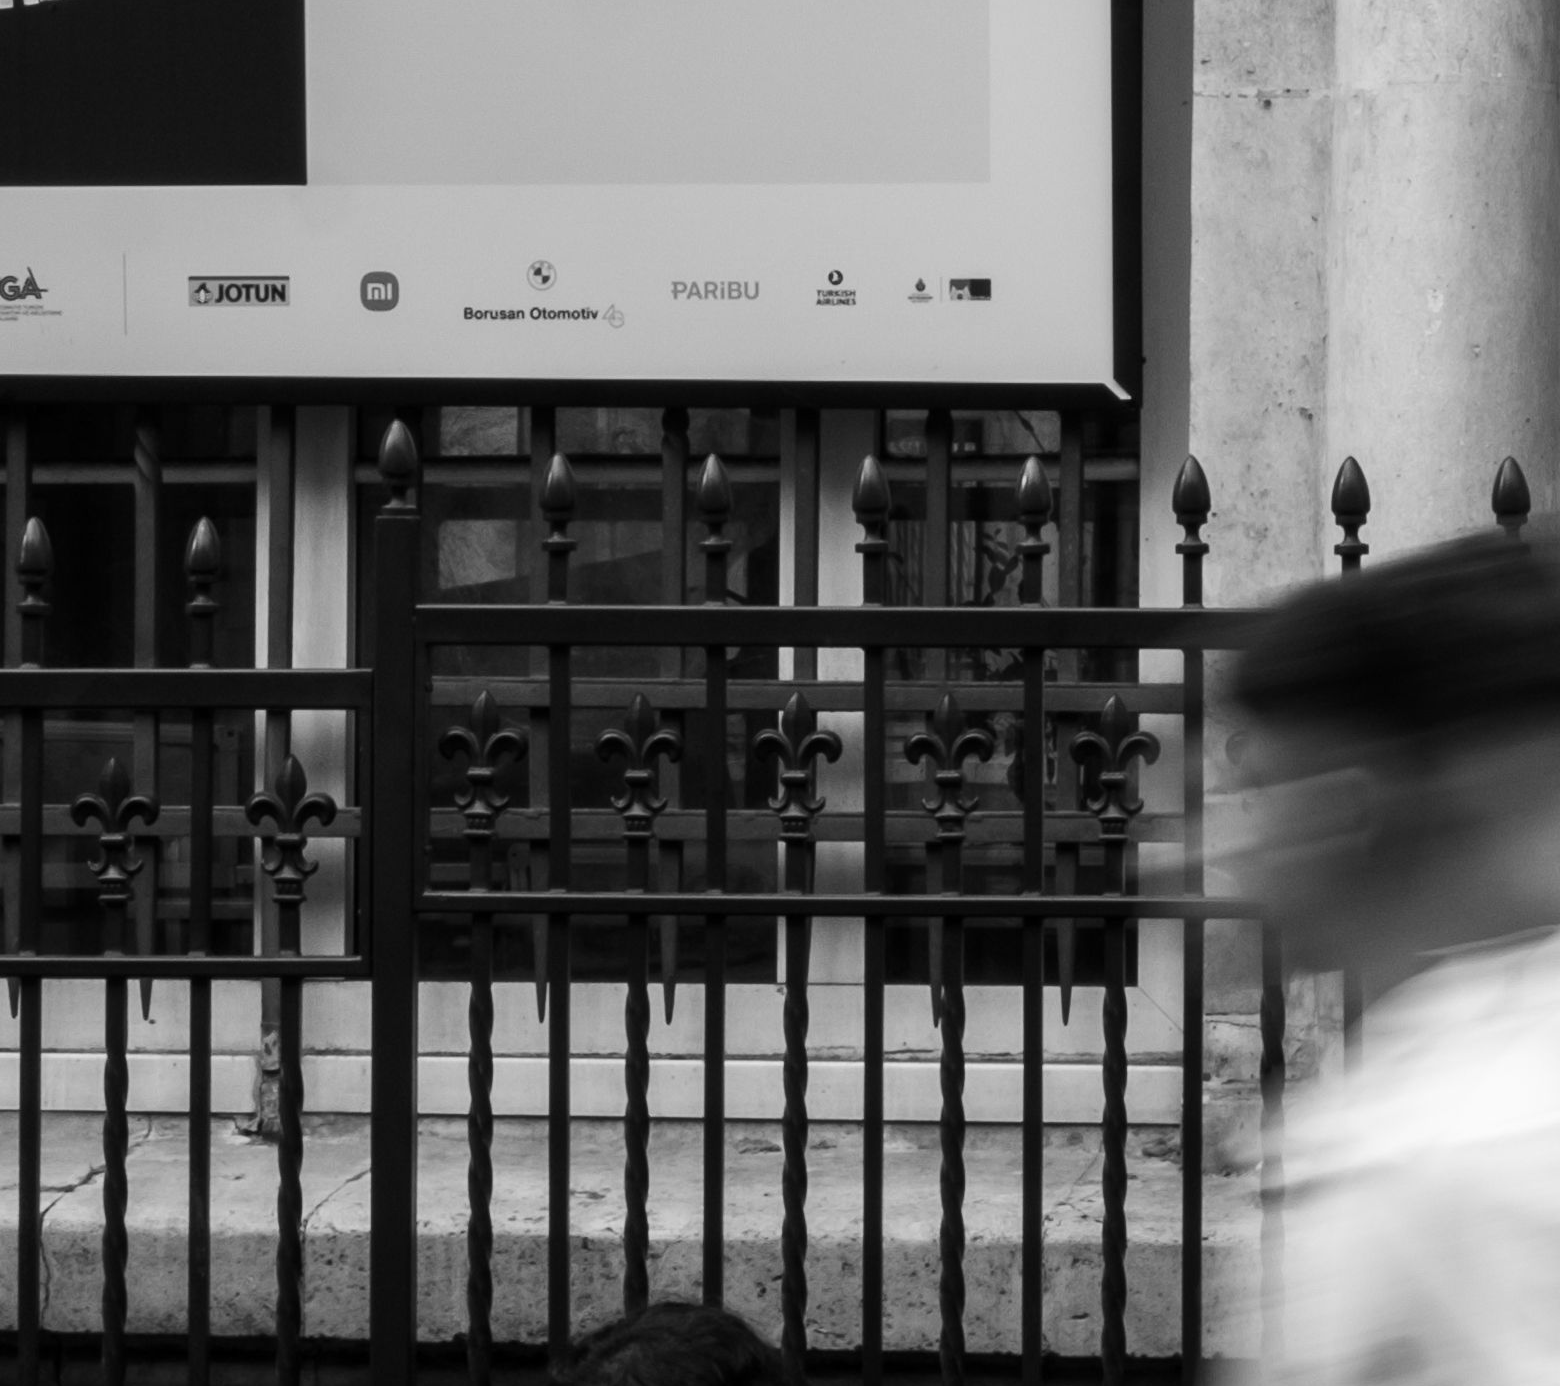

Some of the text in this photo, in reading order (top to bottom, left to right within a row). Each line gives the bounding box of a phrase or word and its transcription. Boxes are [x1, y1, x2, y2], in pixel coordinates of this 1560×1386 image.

[214, 284, 286, 303] JOTUN
[816, 298, 856, 306] AIRLINES
[464, 307, 524, 320] Borusan
[530, 307, 598, 320] Otomotiv
